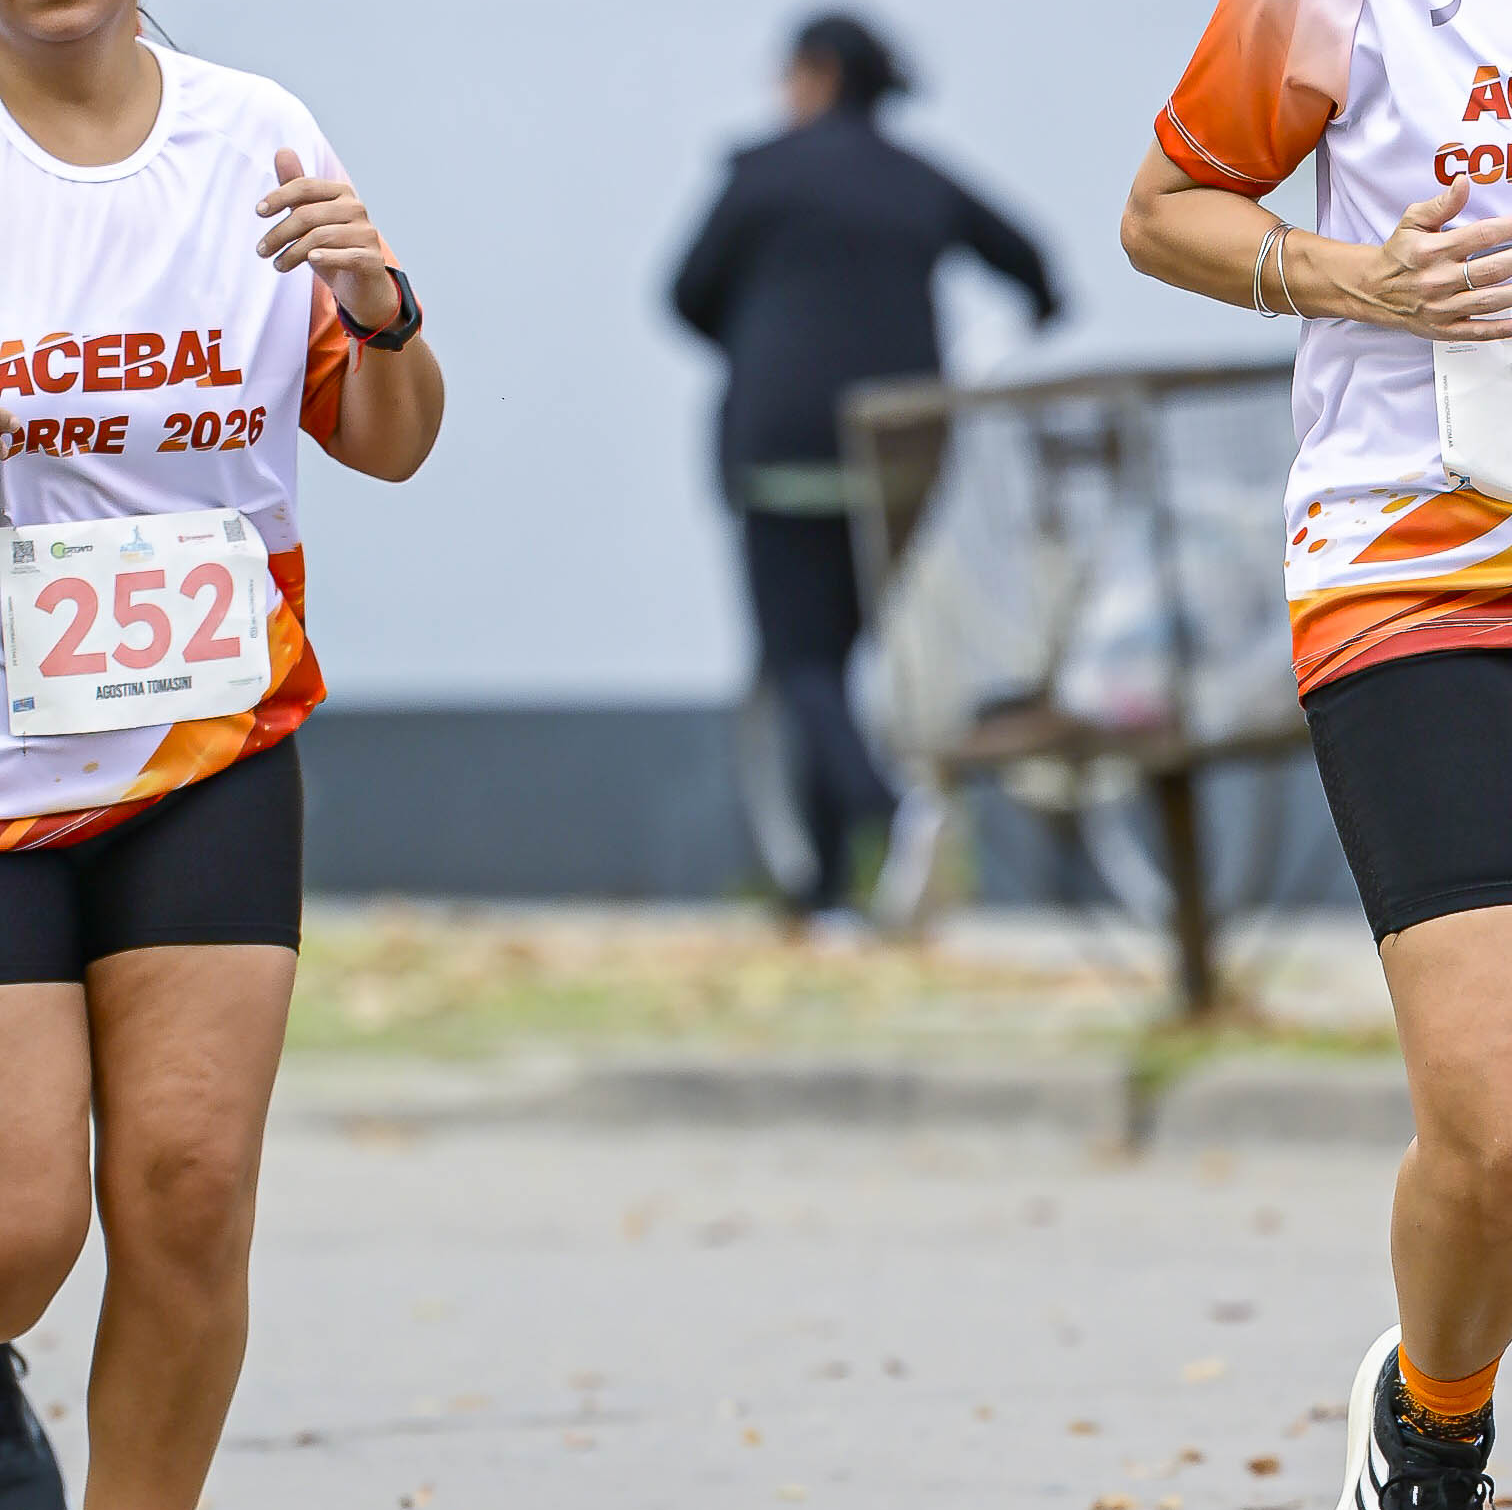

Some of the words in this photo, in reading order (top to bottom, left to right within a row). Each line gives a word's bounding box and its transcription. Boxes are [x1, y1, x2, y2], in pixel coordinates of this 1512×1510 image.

[0, 329, 243, 396] ACEBAL
[157, 406, 267, 454] 2026
[34, 562, 241, 677] 252
[96, 682, 145, 700] AGOSTINA
